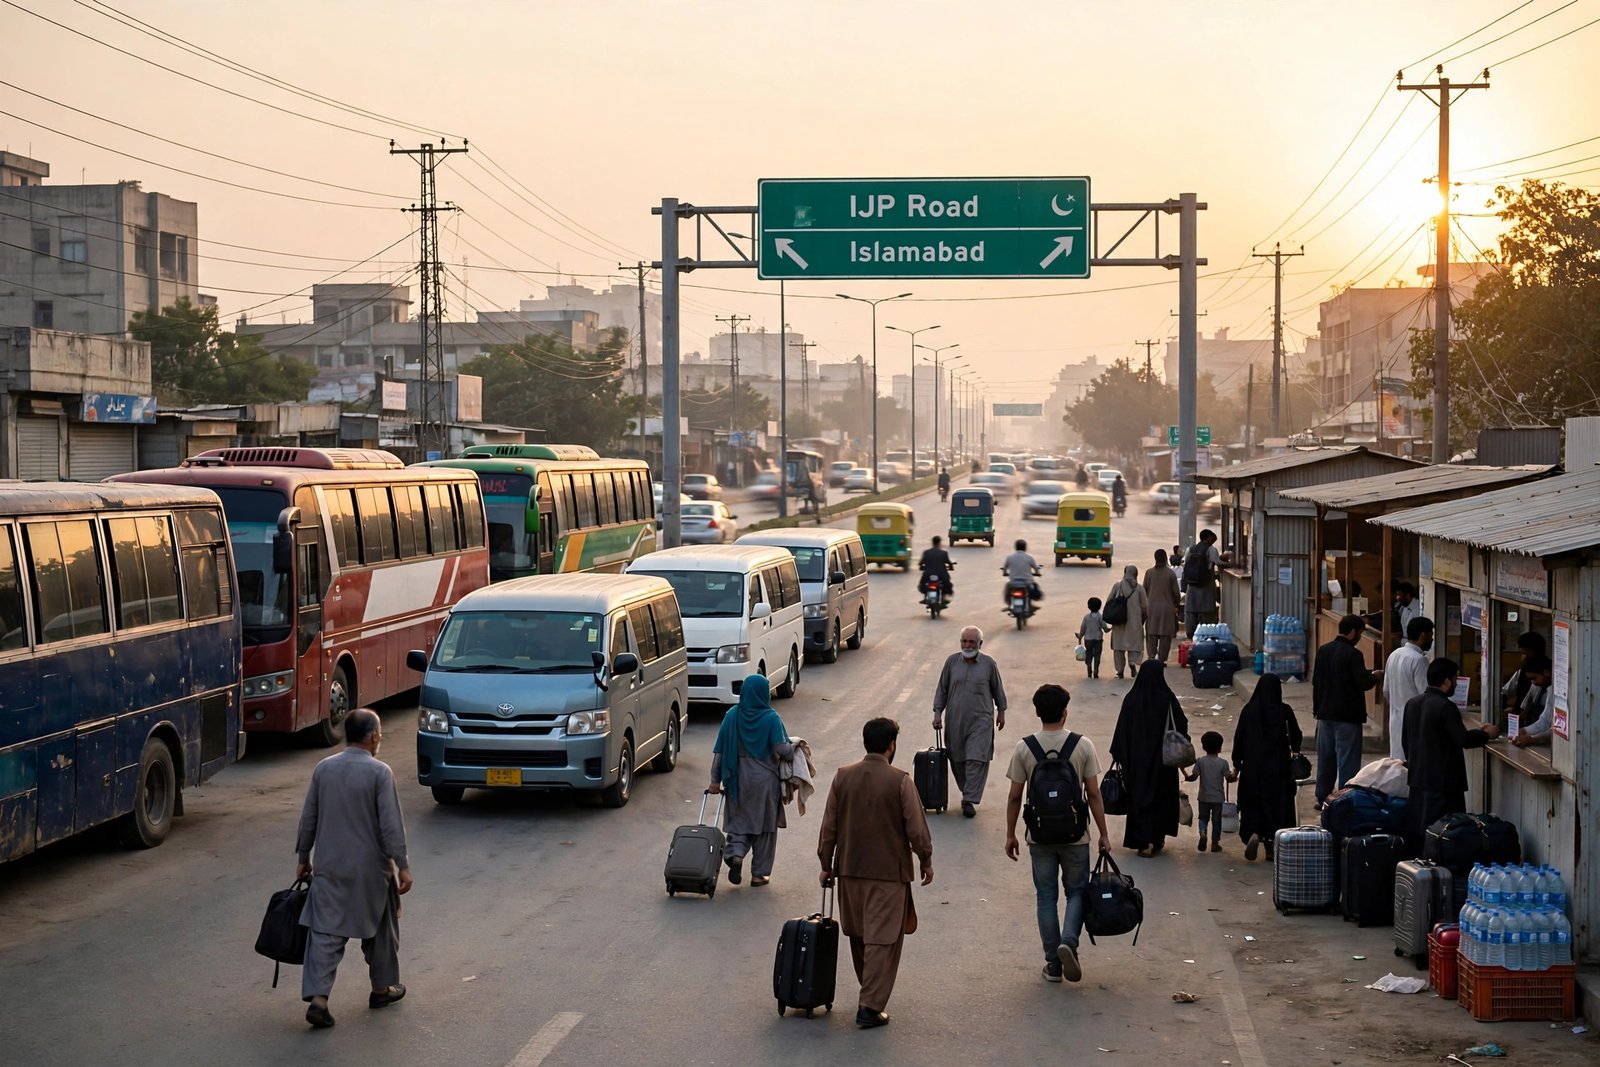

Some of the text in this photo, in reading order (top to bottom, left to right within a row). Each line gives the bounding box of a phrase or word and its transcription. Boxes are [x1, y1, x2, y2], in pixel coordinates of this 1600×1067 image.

[850, 194, 979, 218] IJP Road
[850, 240, 985, 263] Islamabad
